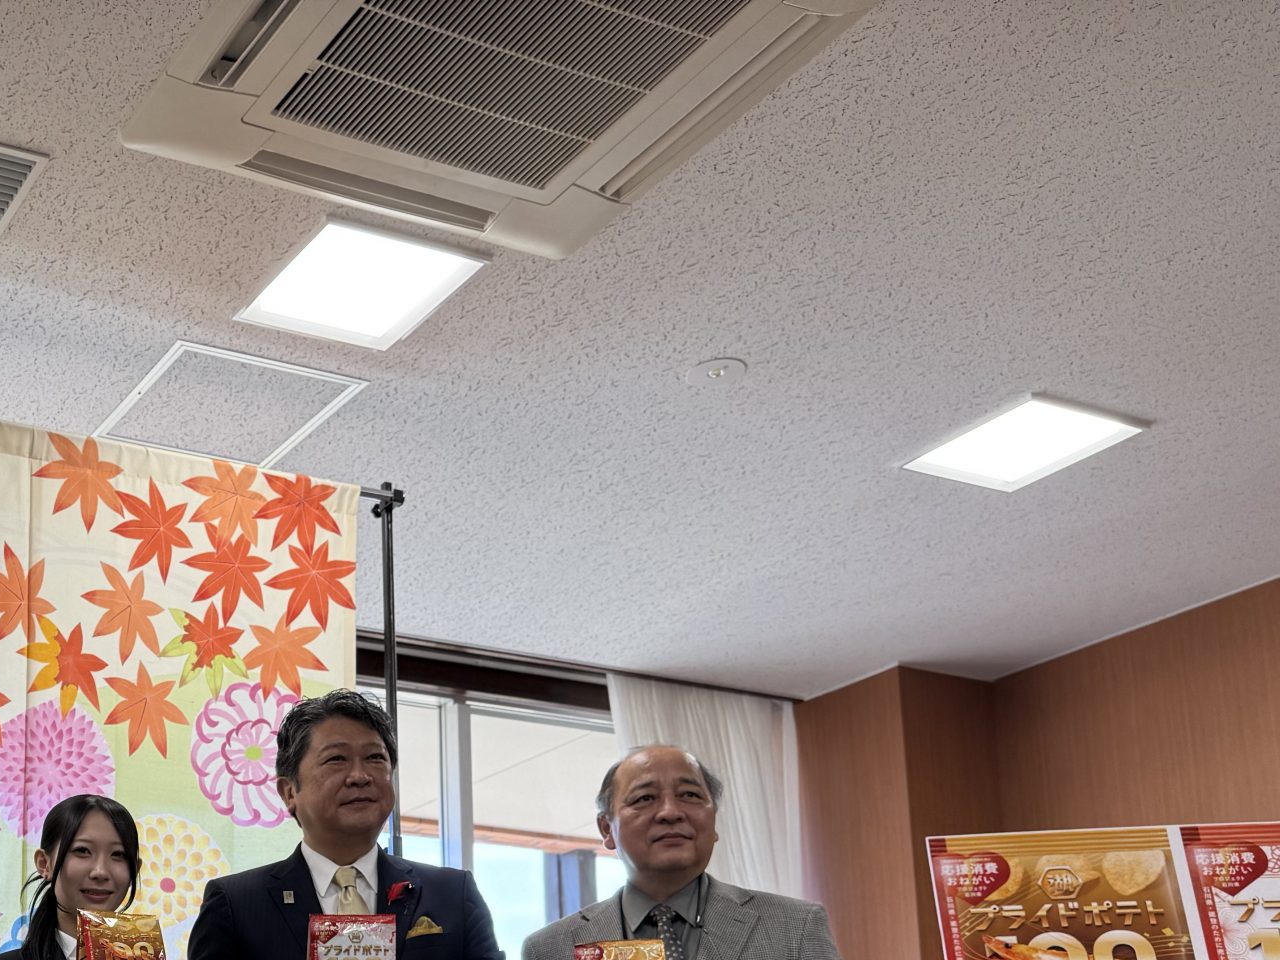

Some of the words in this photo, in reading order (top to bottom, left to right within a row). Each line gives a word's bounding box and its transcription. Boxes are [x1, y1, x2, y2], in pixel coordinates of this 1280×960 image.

[1202, 866, 1253, 876] おねがい
[947, 876, 996, 886] おねがい
[970, 900, 1165, 931] プライドポテト
